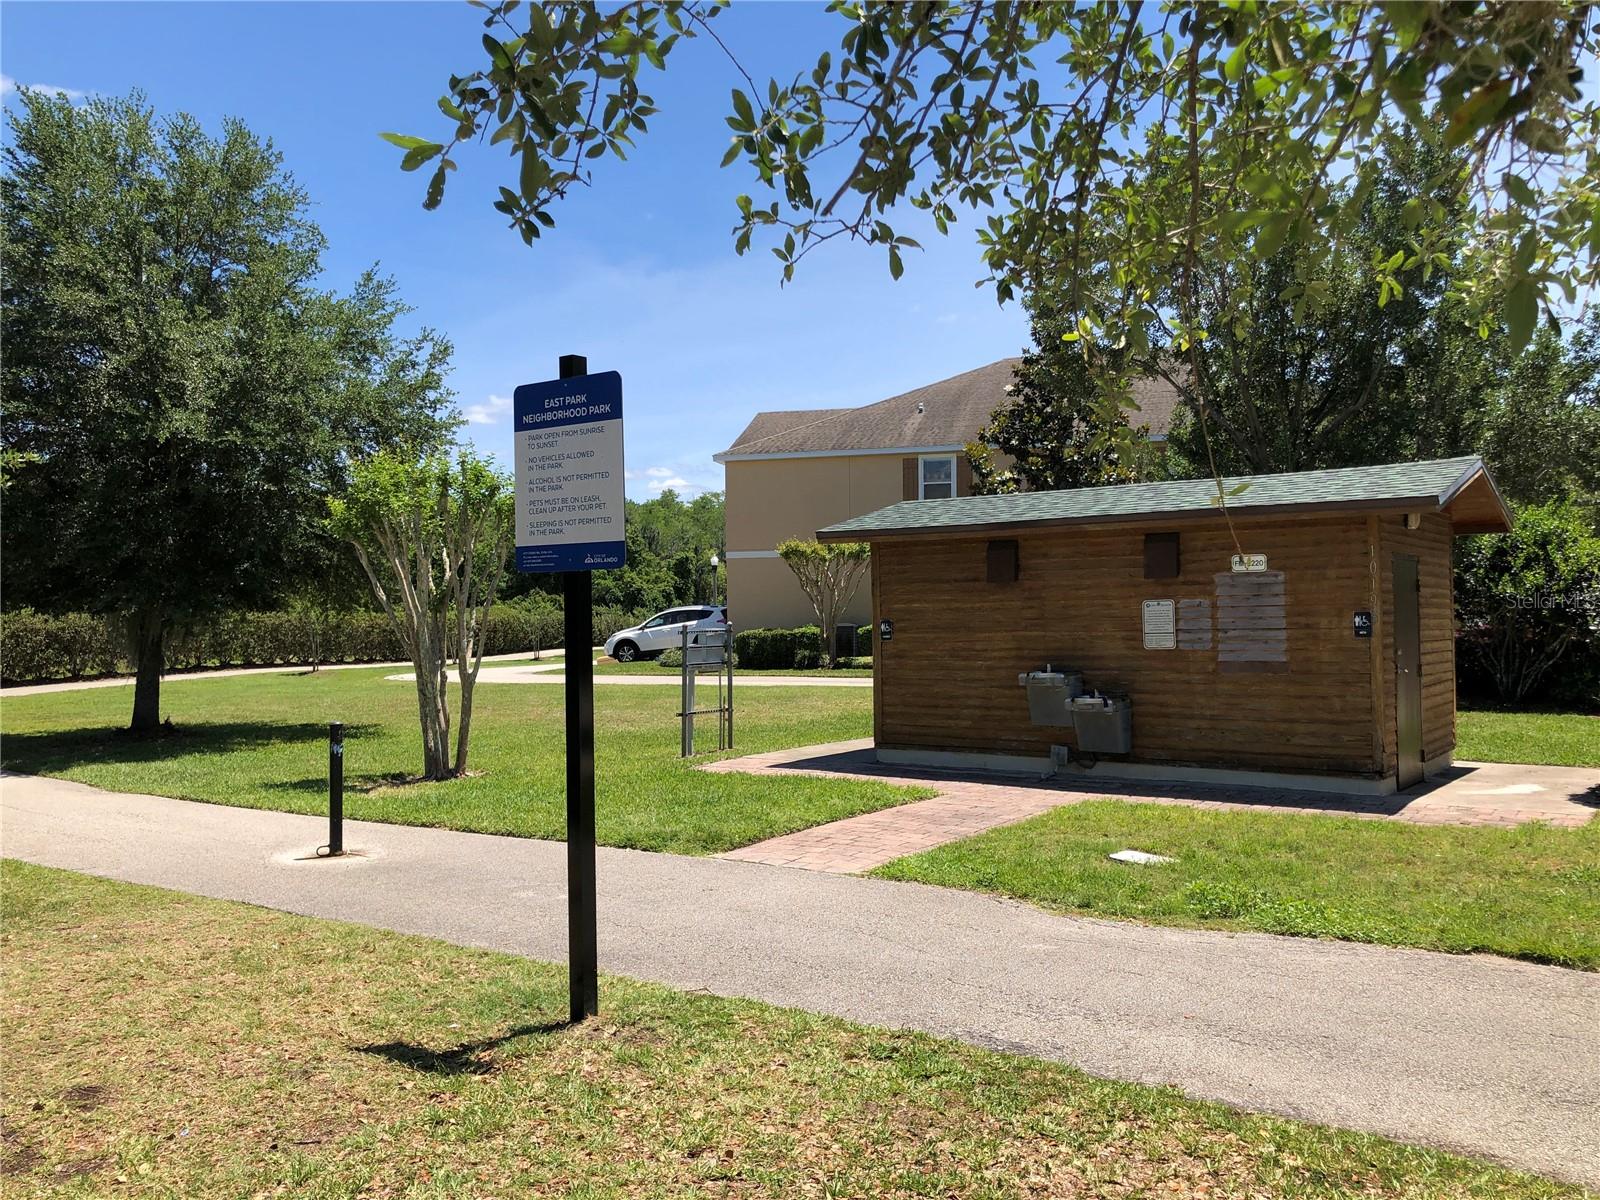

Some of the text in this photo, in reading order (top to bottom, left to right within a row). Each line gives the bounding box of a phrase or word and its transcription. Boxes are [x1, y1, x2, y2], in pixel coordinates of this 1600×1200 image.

[544, 394, 587, 408] EAST PARK
[522, 404, 611, 424] NEIGHBORHOOD PARK
[561, 429, 578, 437] FROM
[579, 426, 605, 435] SUNRISE
[538, 453, 565, 462] VEHICLES
[566, 450, 594, 459] ALLOWED
[529, 477, 555, 485] ALCOHOL
[576, 472, 609, 480] PERMITTED
[529, 507, 548, 515] CLEAN
[529, 520, 557, 528] SLEEPING
[578, 516, 612, 525] PERMITTED
